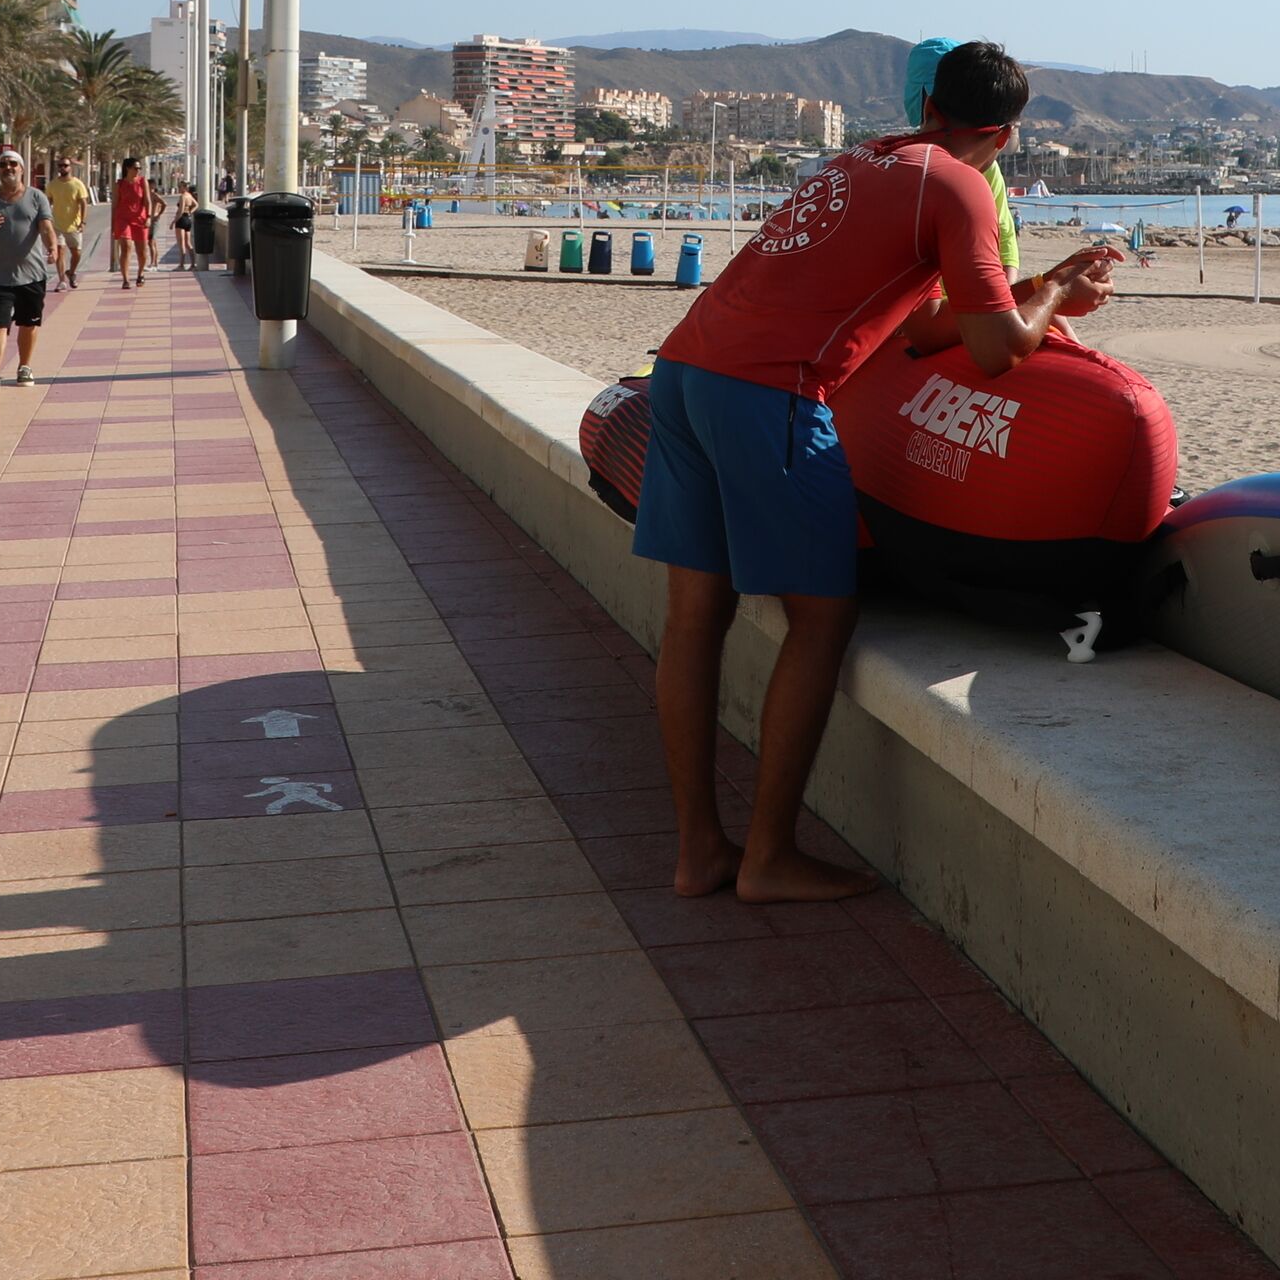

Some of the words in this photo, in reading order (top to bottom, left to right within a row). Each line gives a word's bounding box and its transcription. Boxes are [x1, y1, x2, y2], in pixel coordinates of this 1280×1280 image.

[818, 167, 846, 212] PELLO
[761, 231, 810, 252] CLUB
[898, 372, 994, 446] JOBE
[905, 430, 953, 477] CHASER
[951, 447, 971, 482] IV
